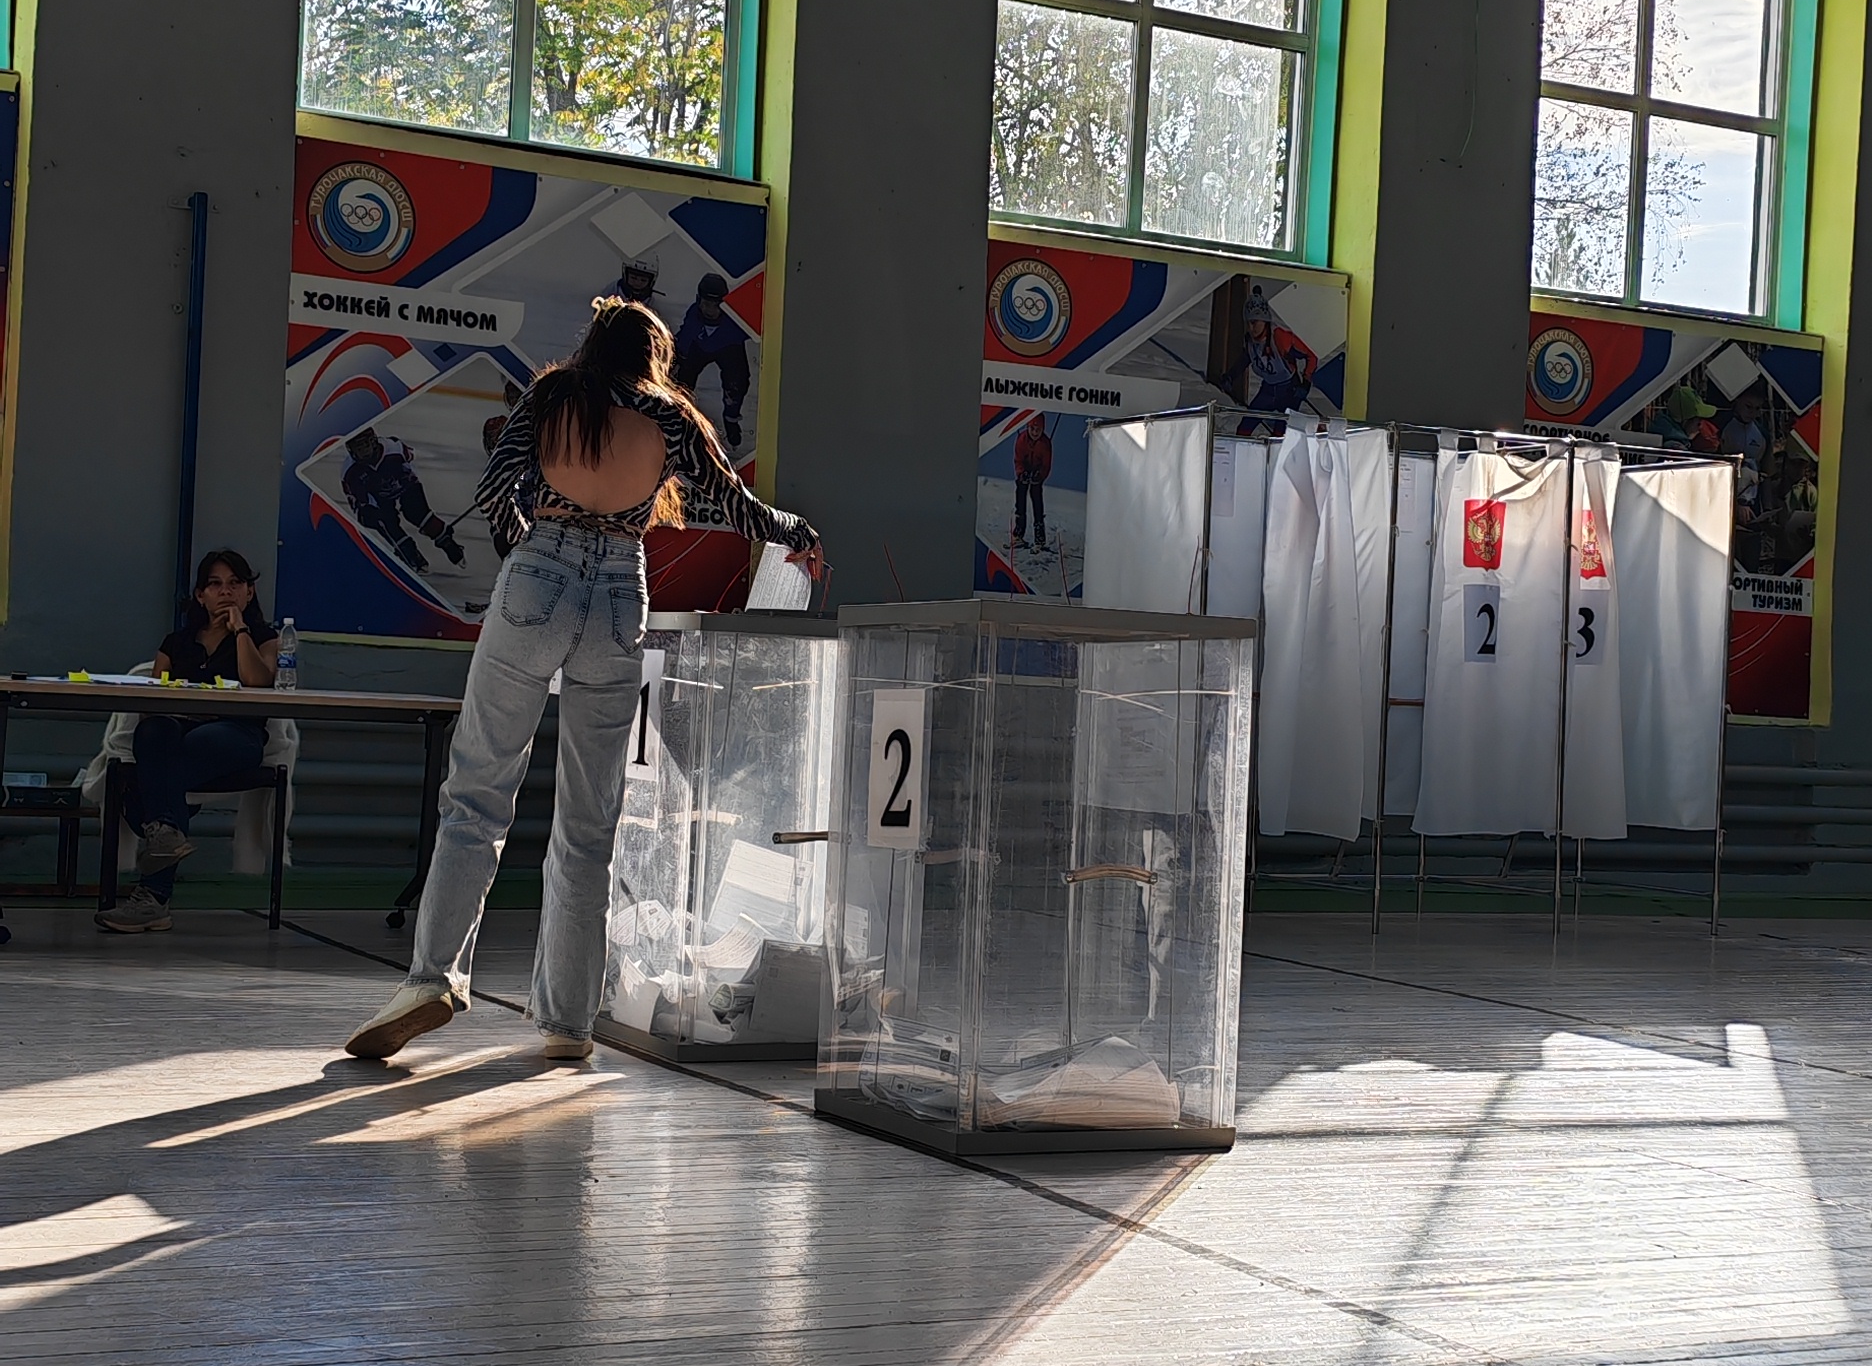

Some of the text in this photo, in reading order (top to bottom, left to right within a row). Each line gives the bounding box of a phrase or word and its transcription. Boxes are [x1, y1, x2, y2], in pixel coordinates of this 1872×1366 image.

[311, 165, 412, 222] ТУРОЧАКСКАЯ ДЮСШ
[303, 290, 498, 332] ХОККЕЙ С МЯЧОМ
[983, 377, 1121, 407] ЛЫЖНЫЕ ГОНКИ
[1733, 576, 1803, 596] ОРТИВНЫЙ
[1751, 594, 1802, 611] ТУРИЗМ
[1476, 603, 1496, 655] 2
[1576, 607, 1595, 658] 3
[632, 681, 650, 766] 1
[880, 728, 912, 827] 2
